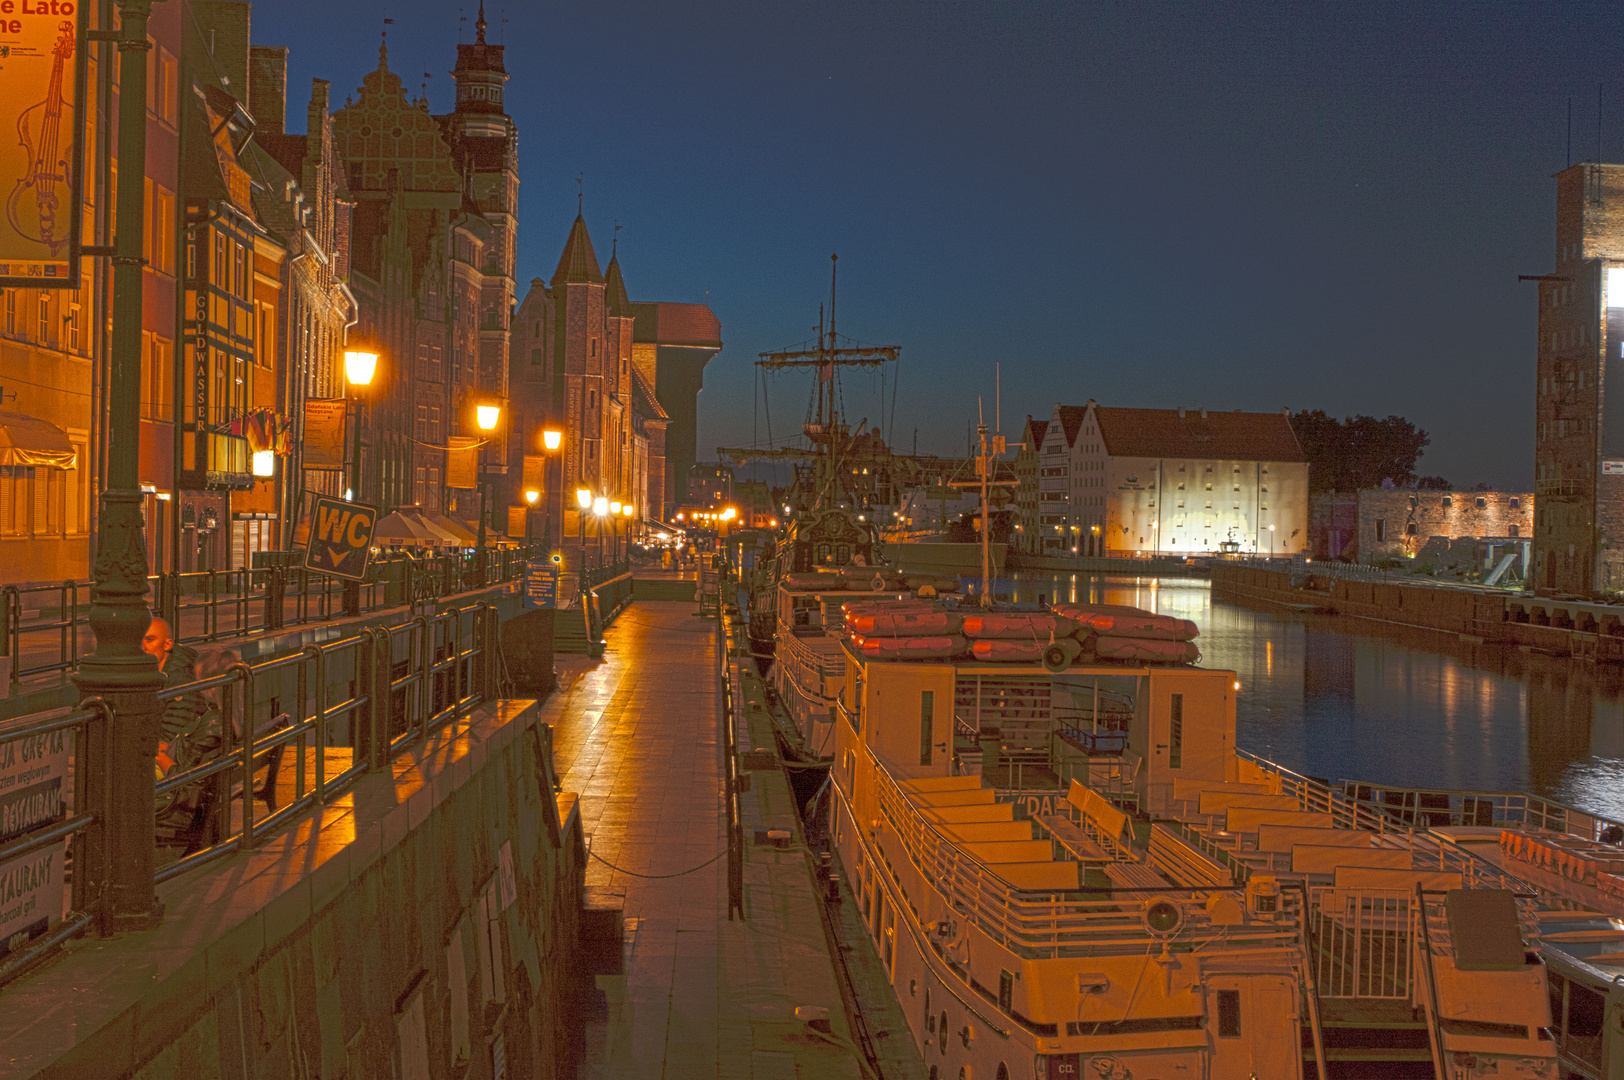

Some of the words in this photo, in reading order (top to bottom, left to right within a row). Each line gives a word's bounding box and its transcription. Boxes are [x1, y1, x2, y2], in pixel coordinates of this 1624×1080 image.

[22, 0, 75, 15] Lato
[196, 296, 206, 432] GOLDWASSER
[318, 506, 371, 548] WC
[17, 764, 51, 785] węglowym
[3, 788, 62, 834] RESTAURANT
[0, 853, 53, 906] TAURANT
[1058, 1064, 1075, 1075] CO.
